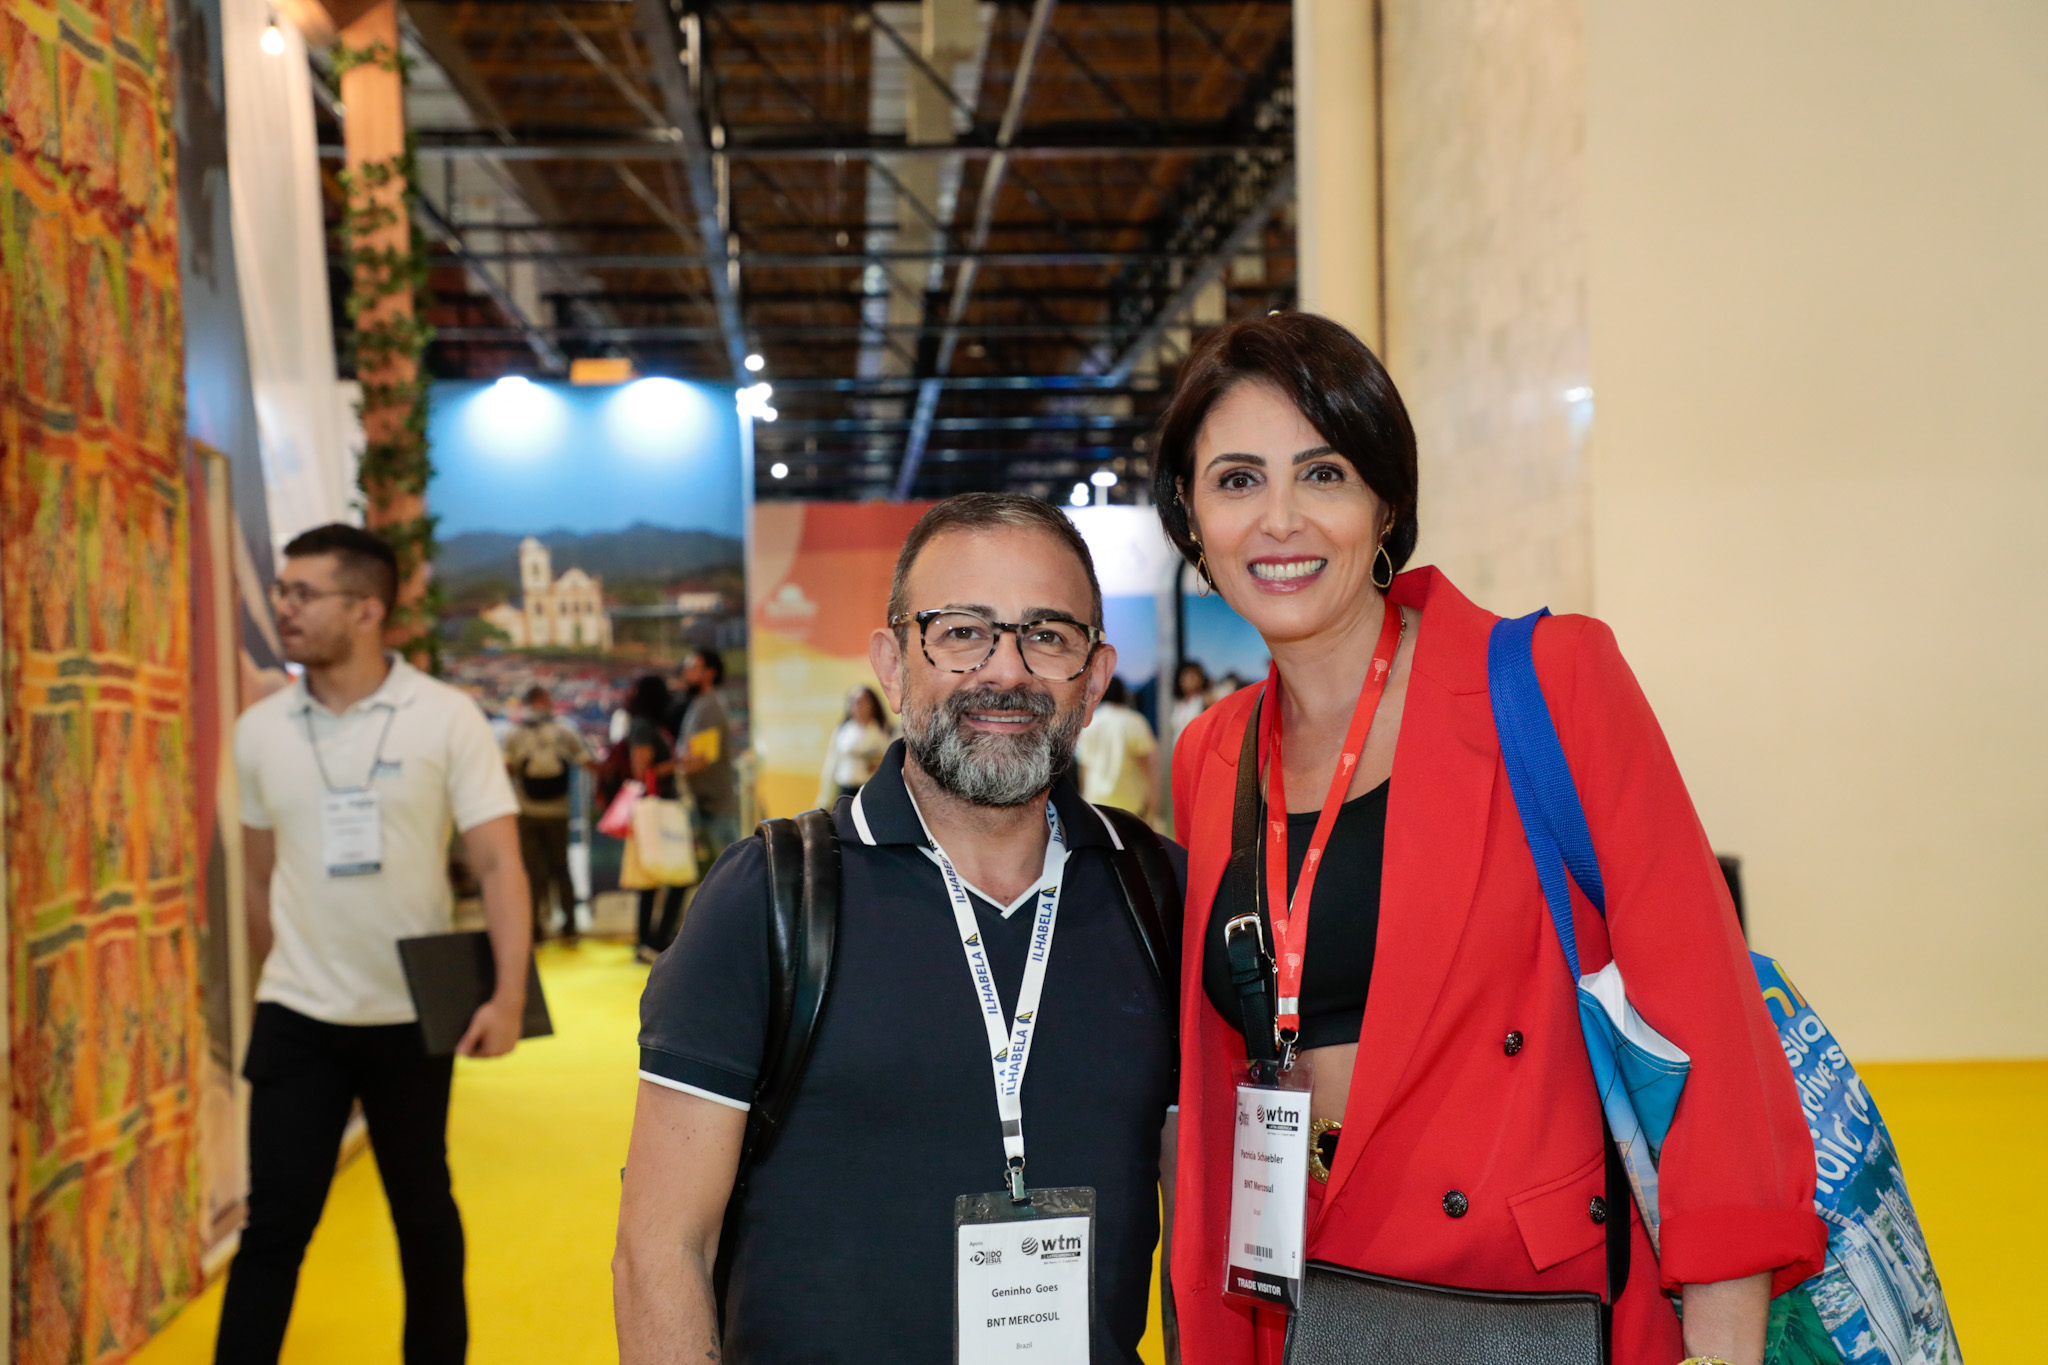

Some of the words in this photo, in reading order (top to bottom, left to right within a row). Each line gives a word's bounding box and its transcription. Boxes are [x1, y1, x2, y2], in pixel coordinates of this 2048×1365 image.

[1031, 903, 1054, 962] ILHABELA
[971, 951, 999, 1014] ILHABELA
[1006, 1029, 1029, 1096] ILHABELA
[1265, 1106, 1299, 1123] wtm
[1244, 1179, 1254, 1189] BNT
[1254, 1181, 1274, 1193] Mercosul
[1041, 1234, 1081, 1251] wtm
[991, 1285, 1032, 1298] Geninho
[1035, 1284, 1058, 1293] Goes
[1237, 1277, 1257, 1291] TRADE
[1256, 1281, 1282, 1296] VISITOR
[986, 1317, 1006, 1328] BNT
[1008, 1311, 1060, 1326] MERCOSUL
[1016, 1341, 1033, 1350] Brazil
